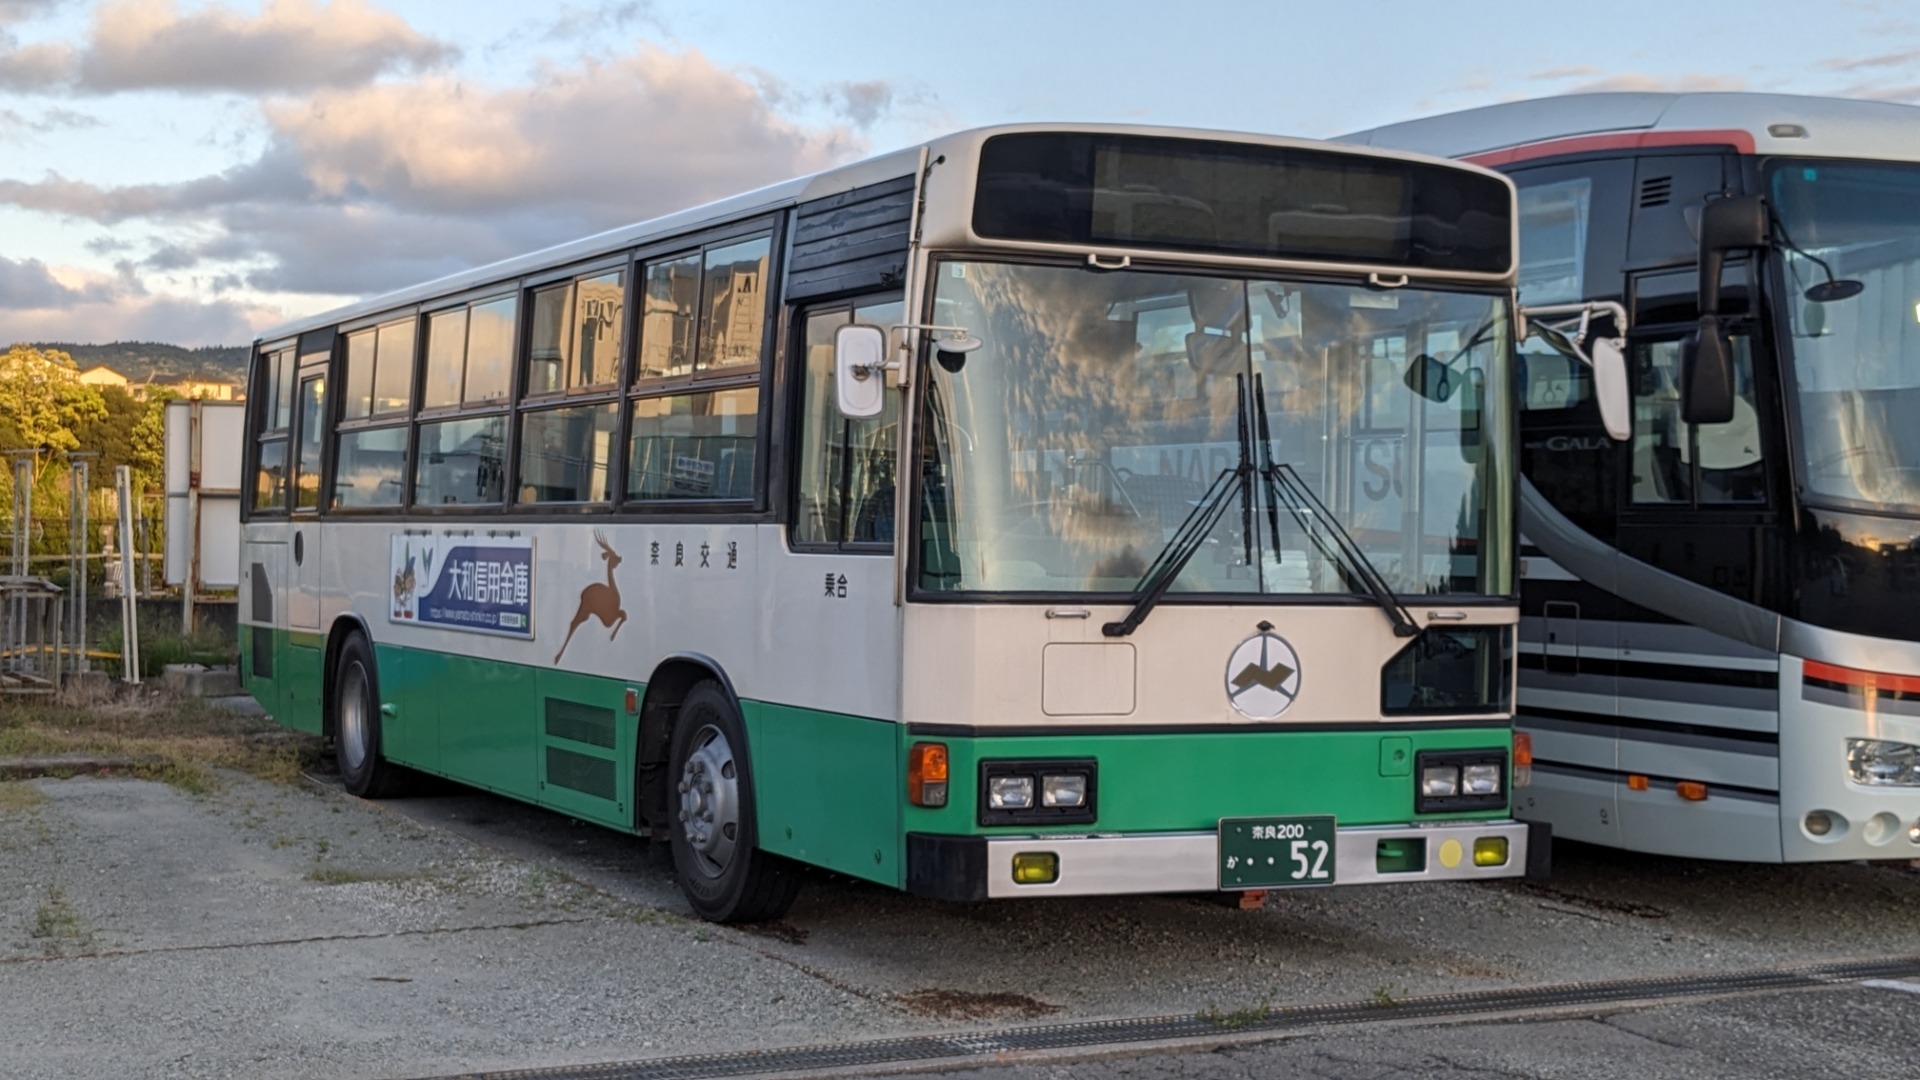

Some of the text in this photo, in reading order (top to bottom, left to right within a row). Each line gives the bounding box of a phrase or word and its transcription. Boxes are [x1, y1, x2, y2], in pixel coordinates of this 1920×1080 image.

[1546, 436, 1610, 451] GALA
[651, 540, 737, 570] 奈良交通
[449, 559, 528, 606] 大和信用金庫
[825, 573, 848, 598] 乗合
[1252, 824, 1304, 840] 奈良200
[1291, 840, 1329, 880] 52
